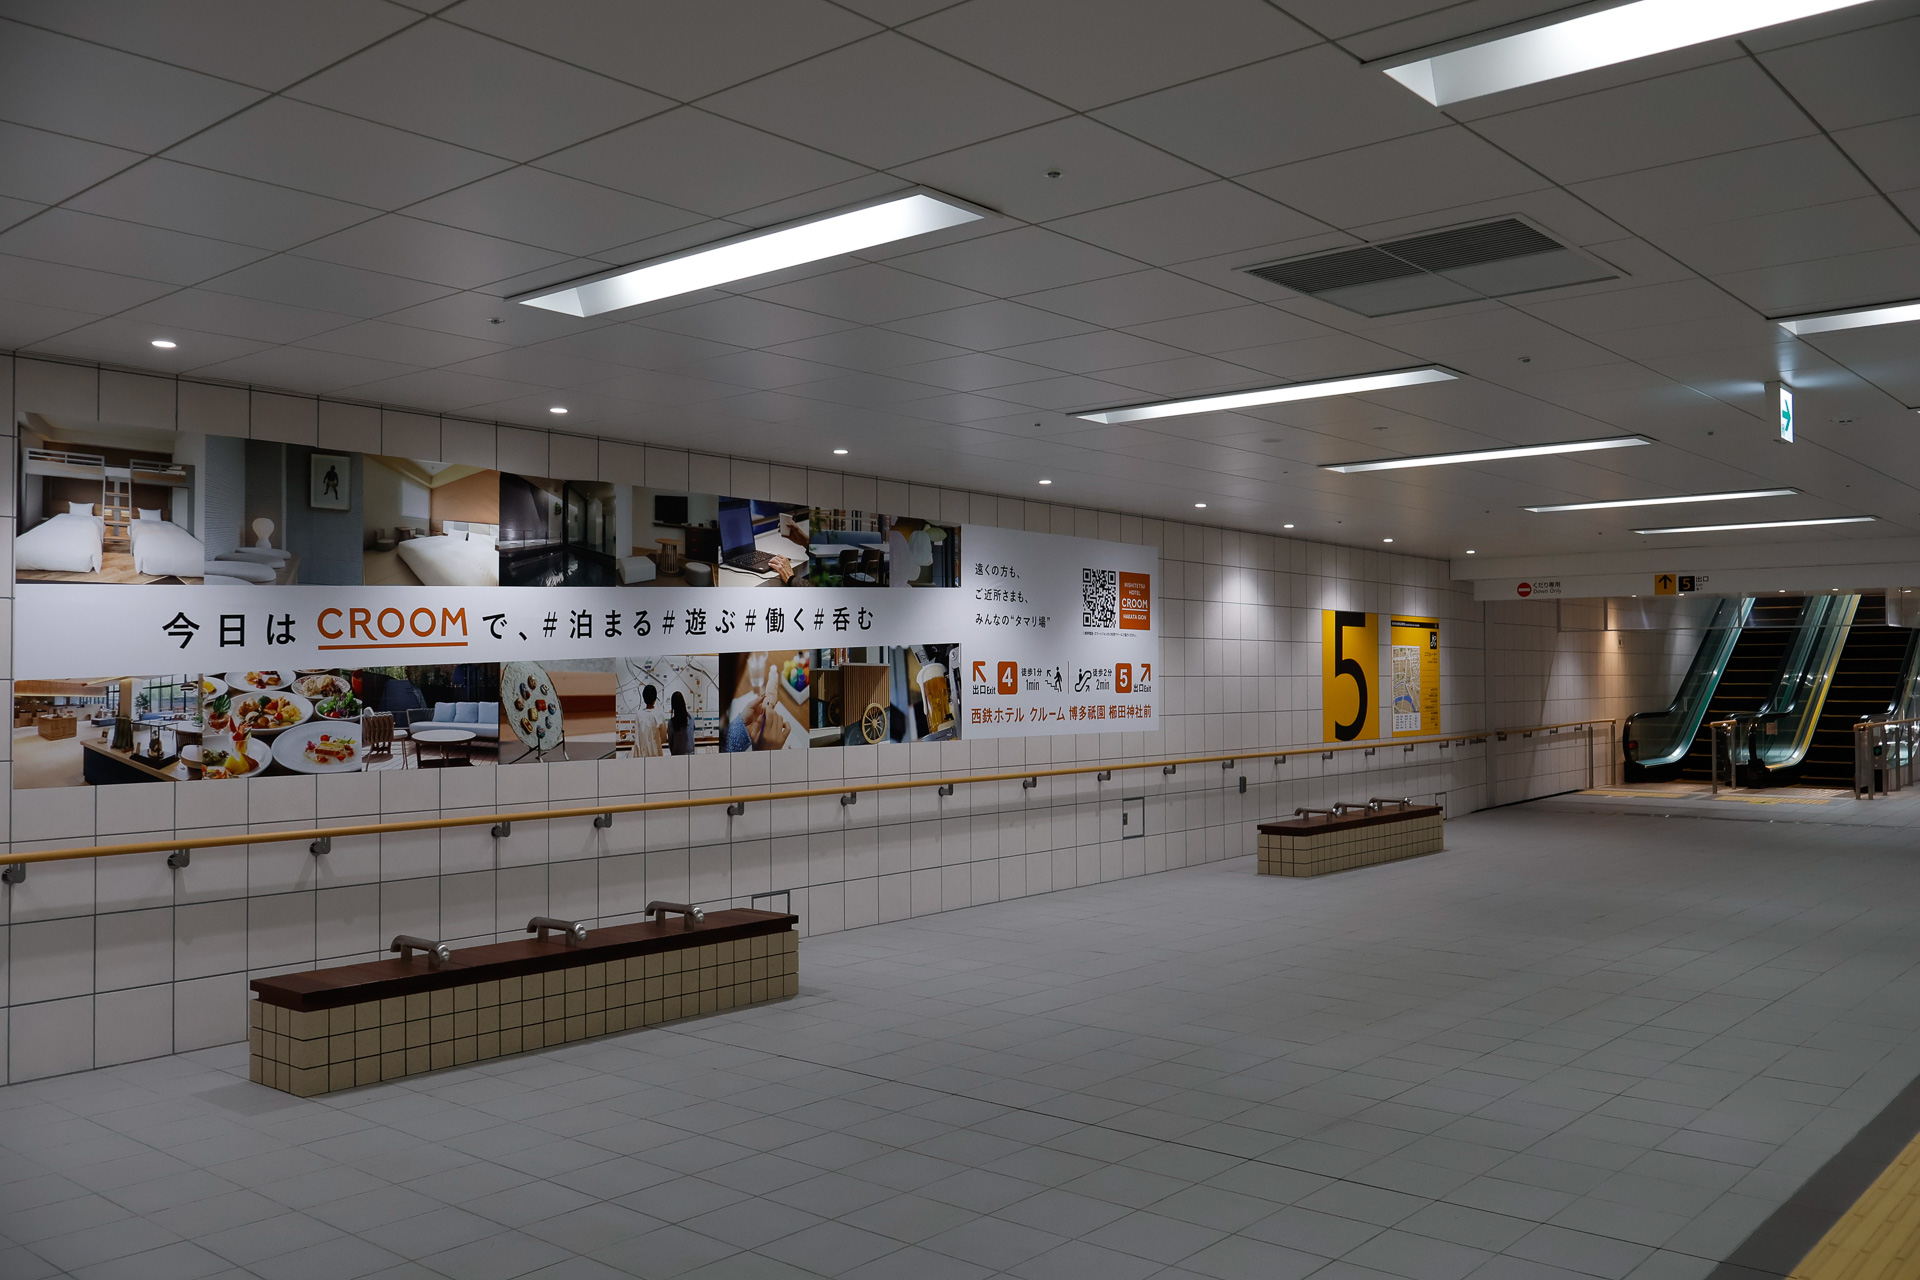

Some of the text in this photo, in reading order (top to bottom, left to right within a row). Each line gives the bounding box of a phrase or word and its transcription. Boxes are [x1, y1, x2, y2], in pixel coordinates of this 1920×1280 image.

[975, 563, 1020, 579] 遠くの方も、
[1682, 577, 1691, 590] 5
[1695, 575, 1709, 583] 出口
[975, 588, 1028, 604] ご近所さまも、
[1121, 598, 1148, 609] CROOM
[317, 607, 469, 642] CROOM
[1002, 667, 1013, 687] 4
[1021, 668, 1042, 676] 徒歩1分
[1093, 668, 1112, 676] 徒歩2分
[1119, 668, 1128, 687] 5
[1335, 610, 1368, 741] 5
[1026, 679, 1039, 690] 1min
[1096, 679, 1110, 690] 2min
[971, 707, 1025, 724] 西鉄ホテル
[1029, 706, 1066, 722] クルーム
